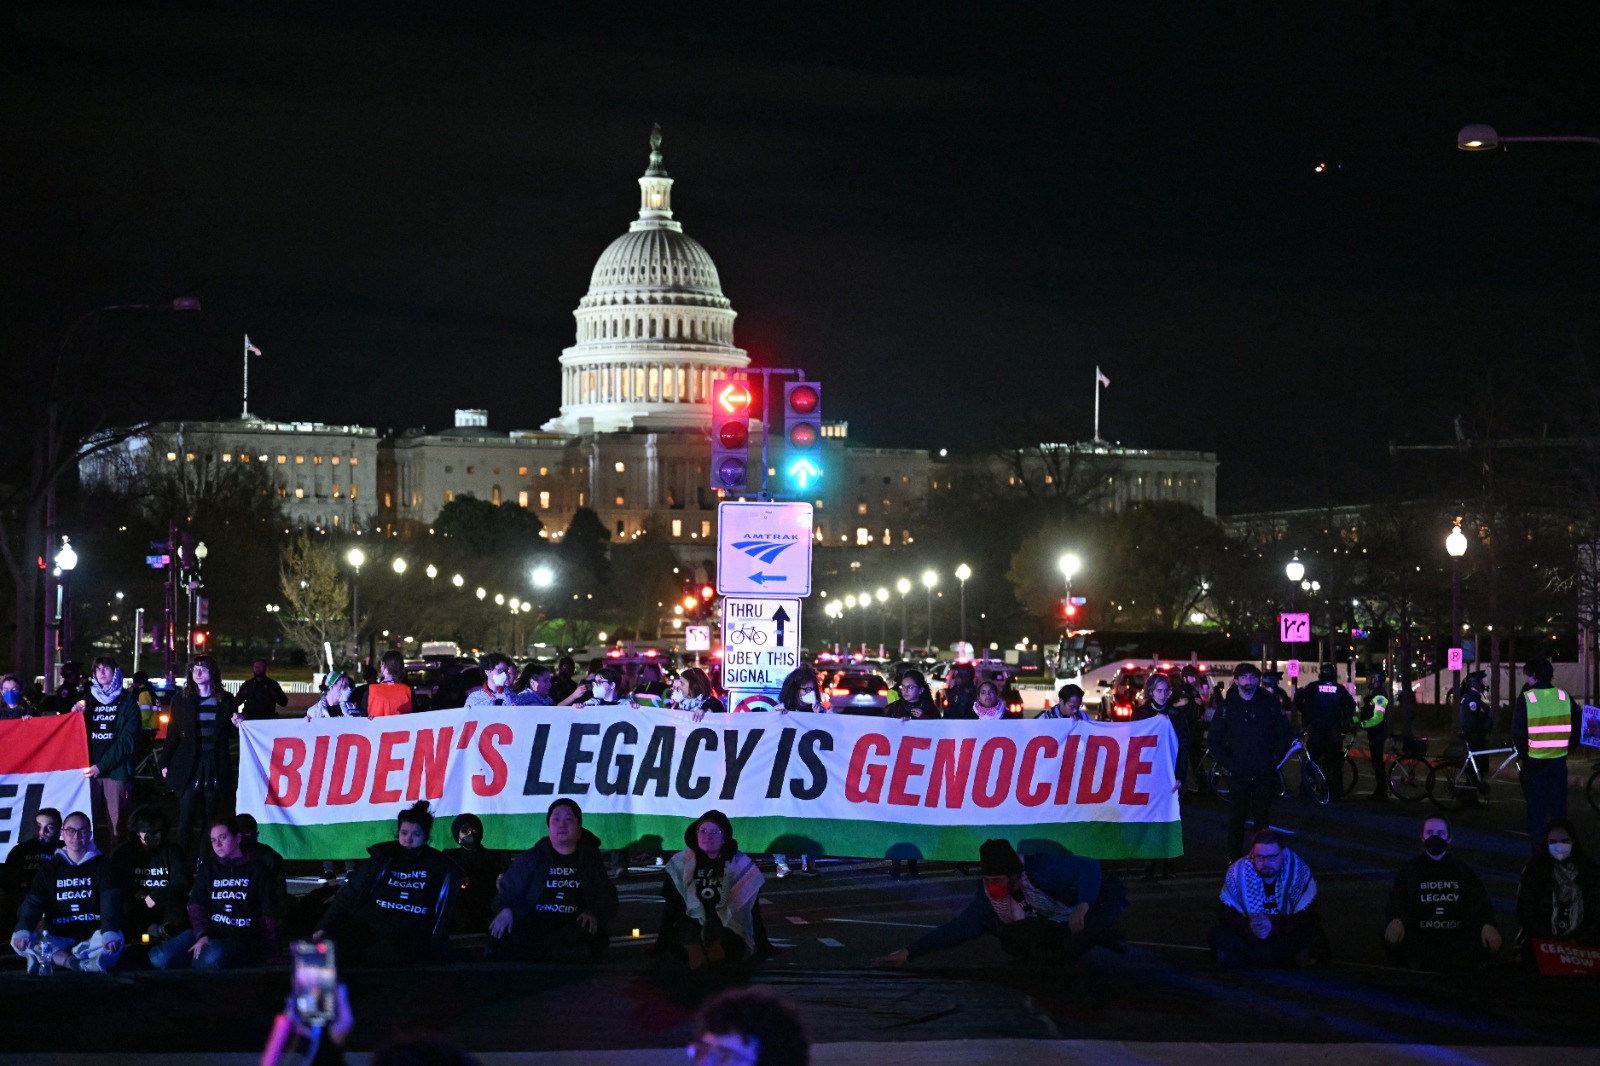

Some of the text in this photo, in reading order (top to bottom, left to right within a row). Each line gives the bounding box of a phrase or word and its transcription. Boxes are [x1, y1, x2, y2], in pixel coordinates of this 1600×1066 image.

[729, 603, 763, 618] THRU
[768, 652, 795, 666] THIS
[727, 669, 773, 684] SIGNAL
[265, 720, 1158, 810] BIDEN'S LEGACY IS GENOCIDE
[56, 877, 92, 888] BIDEN'S
[213, 878, 250, 888] BIDEN'S
[388, 877, 426, 890] LEGACY
[546, 879, 581, 889] LEGACY
[1420, 881, 1460, 890] BIDEN'S
[56, 889, 93, 901] LEGACY
[211, 890, 247, 900] LEGACY
[1420, 893, 1460, 902] LEGACY
